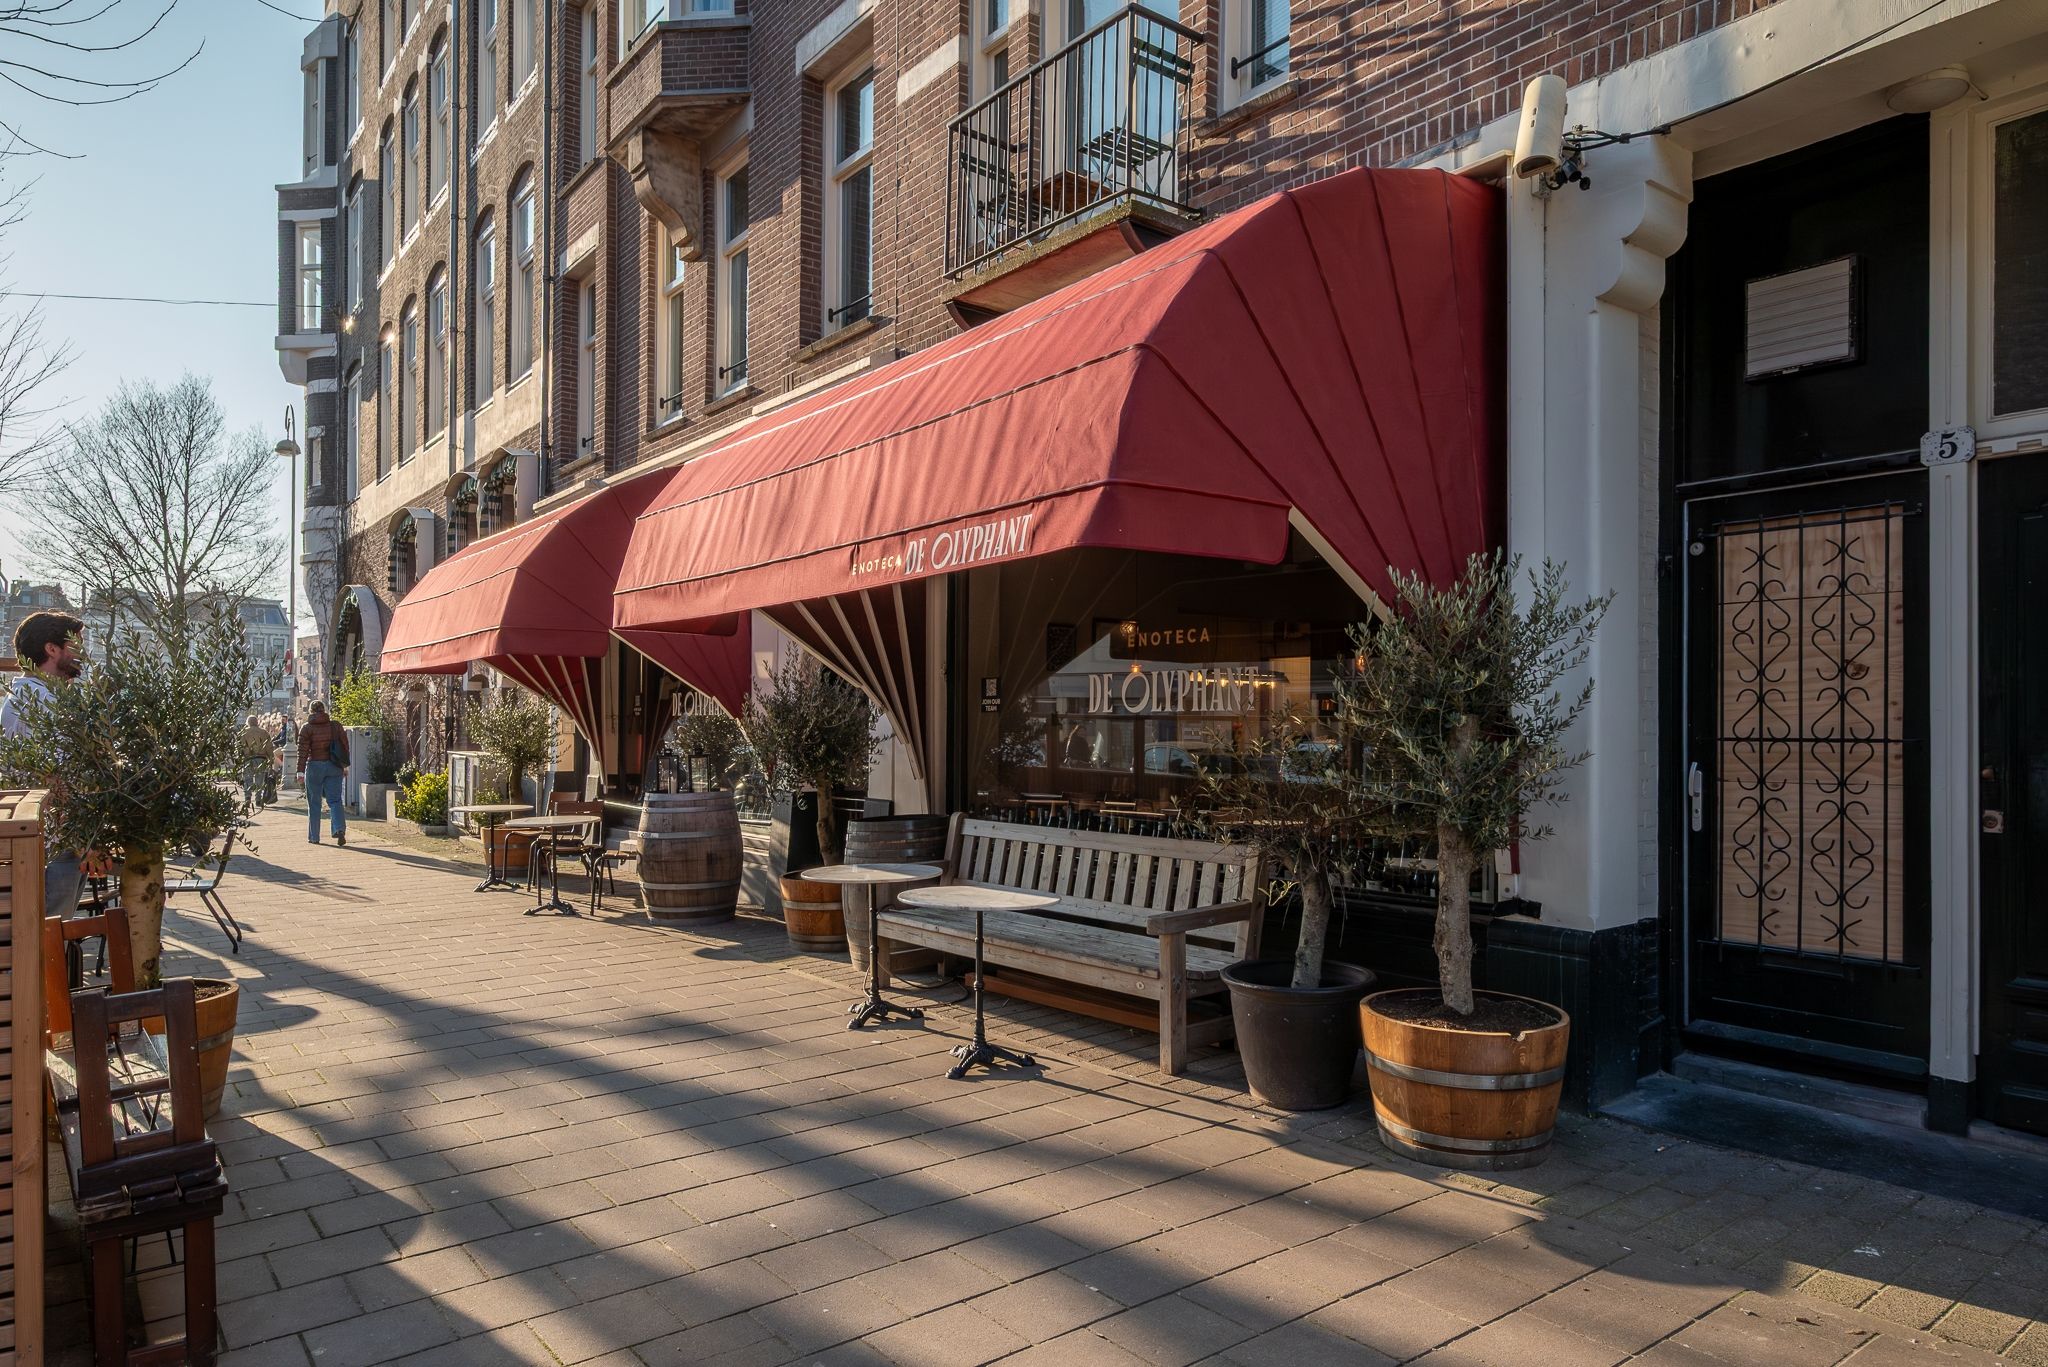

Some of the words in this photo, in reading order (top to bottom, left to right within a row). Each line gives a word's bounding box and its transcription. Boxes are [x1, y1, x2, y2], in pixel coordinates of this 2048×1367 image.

[1938, 431, 1958, 459] 5
[852, 554, 902, 576] ENOTECA
[904, 537, 927, 576] DE
[931, 513, 1033, 570] OLYPHANT
[1127, 627, 1211, 648] ENOTECA
[1088, 673, 1114, 713] DE
[1121, 666, 1259, 714] OLYPHANT
[672, 692, 682, 717] DE
